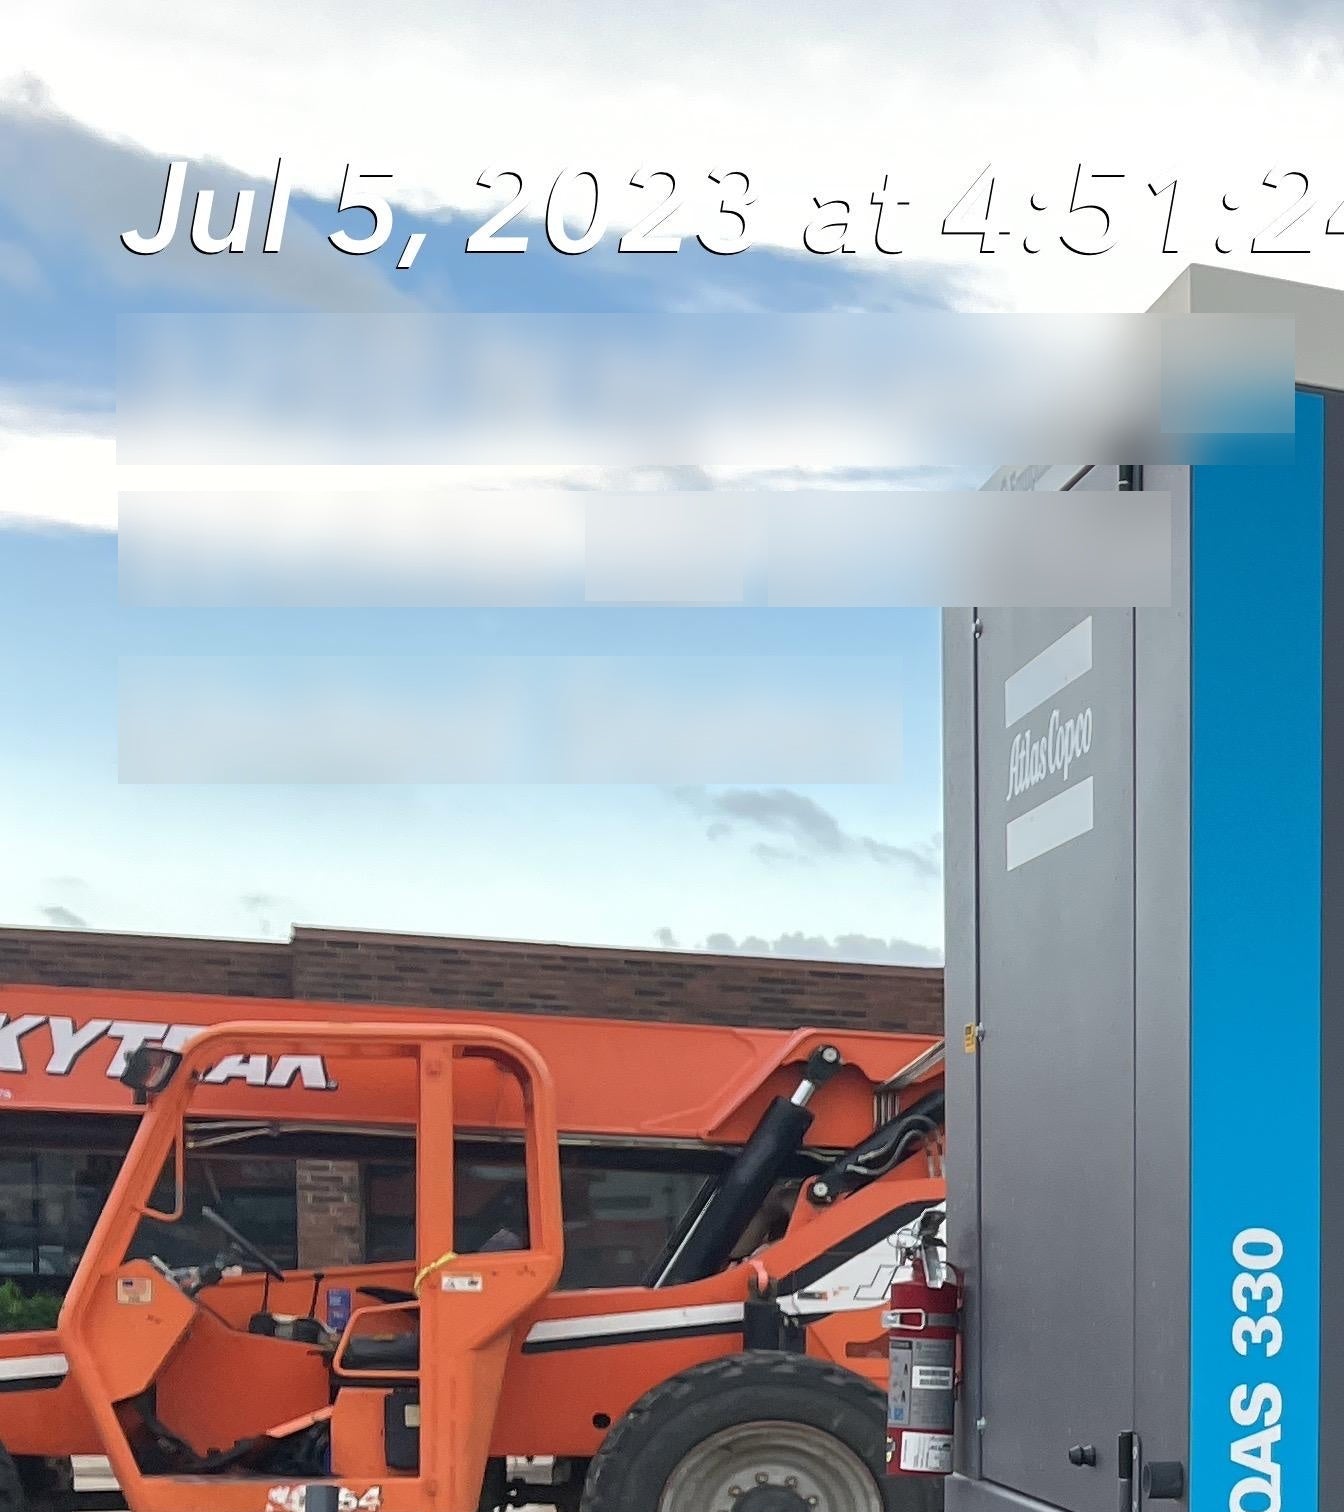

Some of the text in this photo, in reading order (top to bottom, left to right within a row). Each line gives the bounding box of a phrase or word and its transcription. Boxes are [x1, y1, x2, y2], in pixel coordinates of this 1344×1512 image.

[1006, 706, 1093, 801] Atlas Copco
[1231, 1227, 1284, 1358] 330
